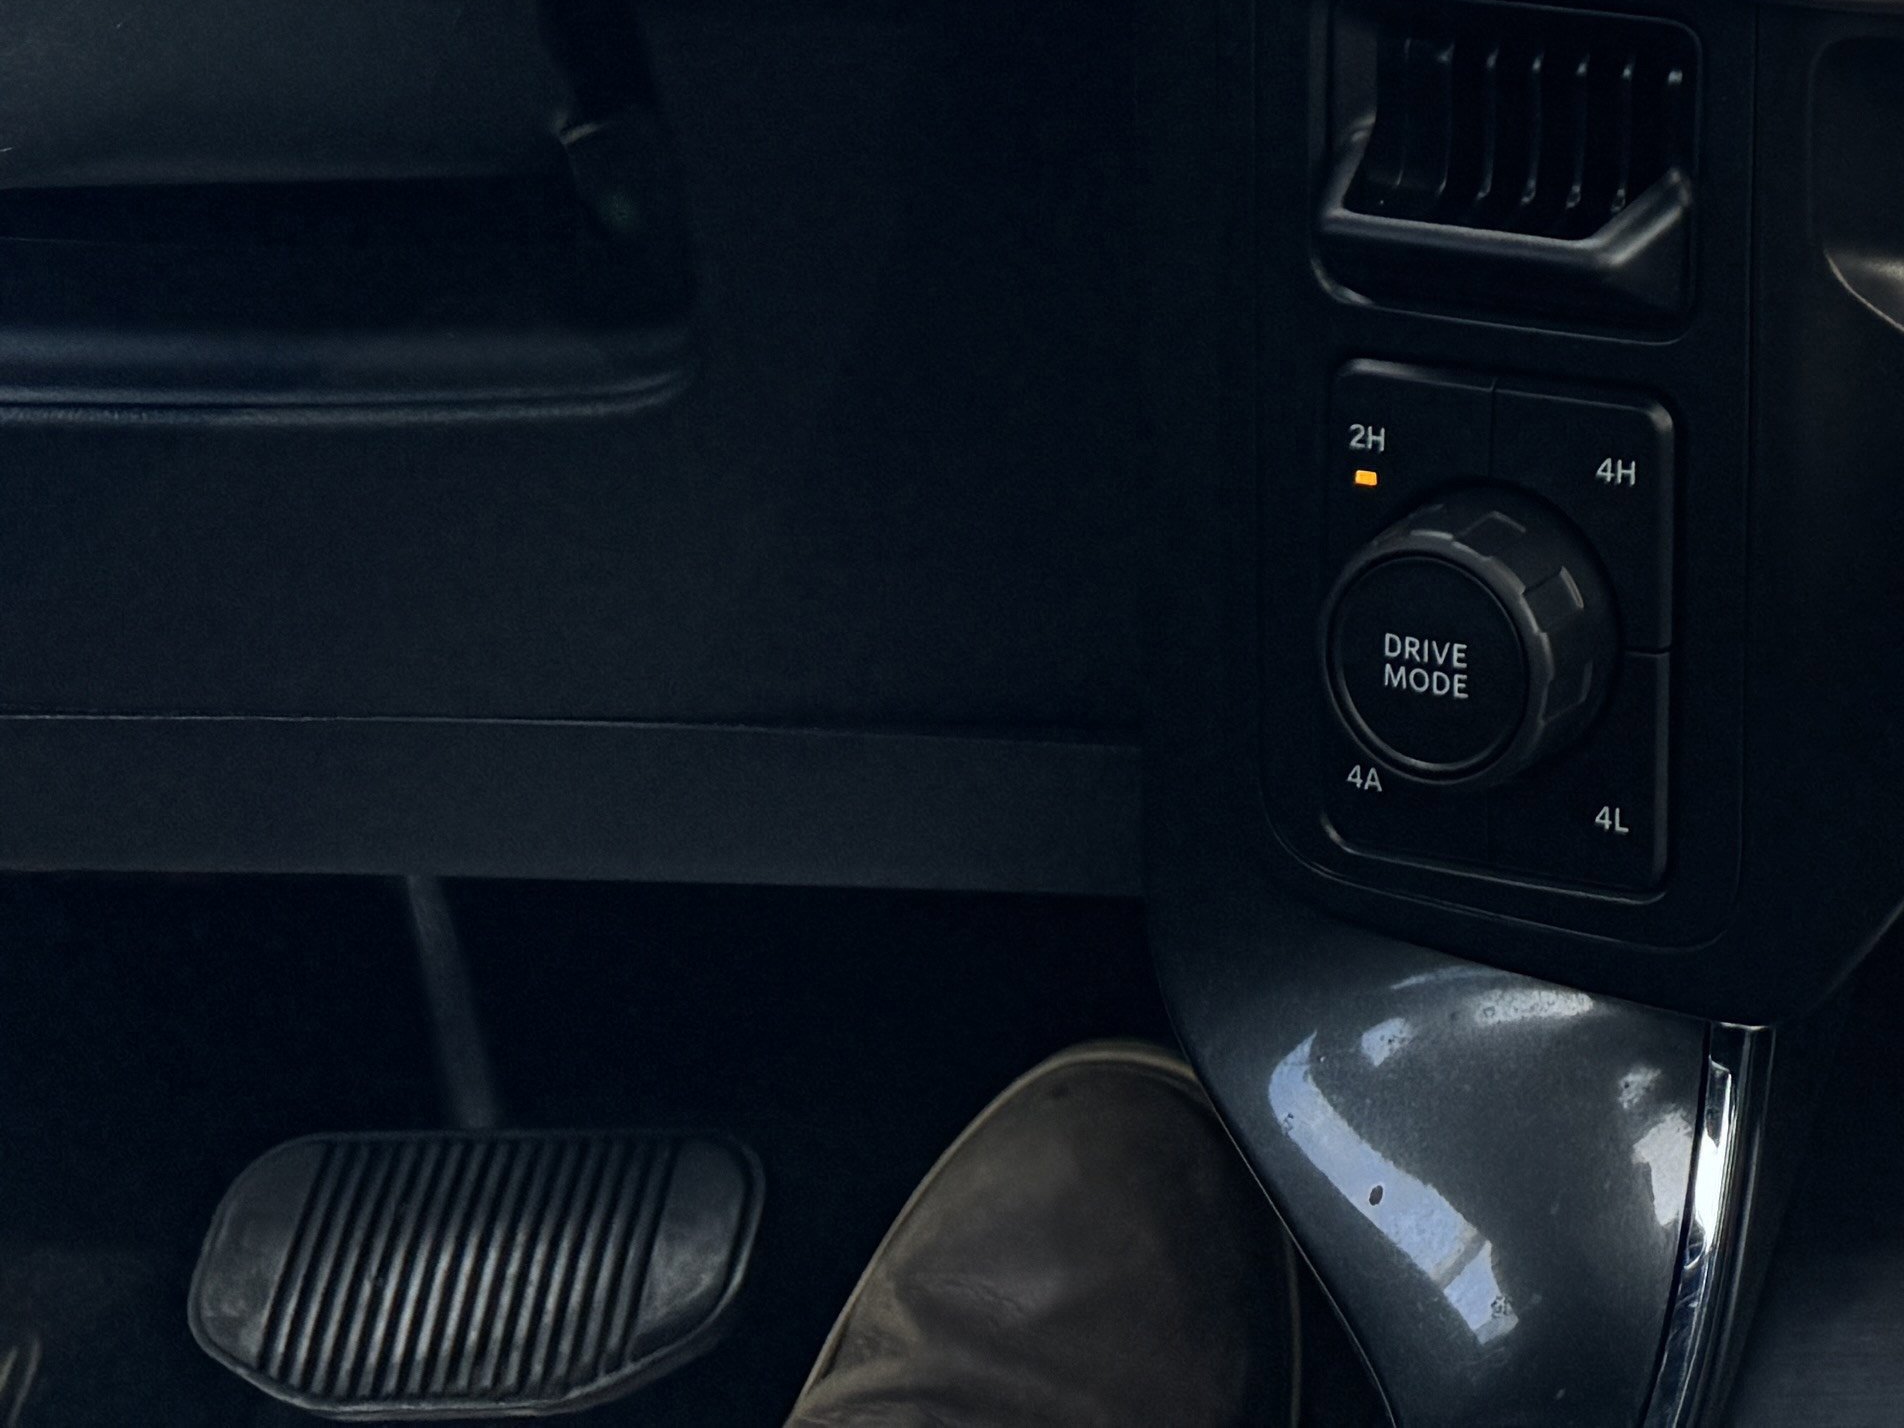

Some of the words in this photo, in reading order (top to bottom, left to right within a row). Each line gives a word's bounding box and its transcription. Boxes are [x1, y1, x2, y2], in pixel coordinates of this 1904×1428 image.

[1350, 424, 1385, 451] 2H
[1596, 458, 1635, 485] 4H
[1384, 632, 1468, 669] DRIVE
[1384, 663, 1469, 699] MODE
[1347, 765, 1382, 791] 4A
[1595, 806, 1629, 832] 4L
